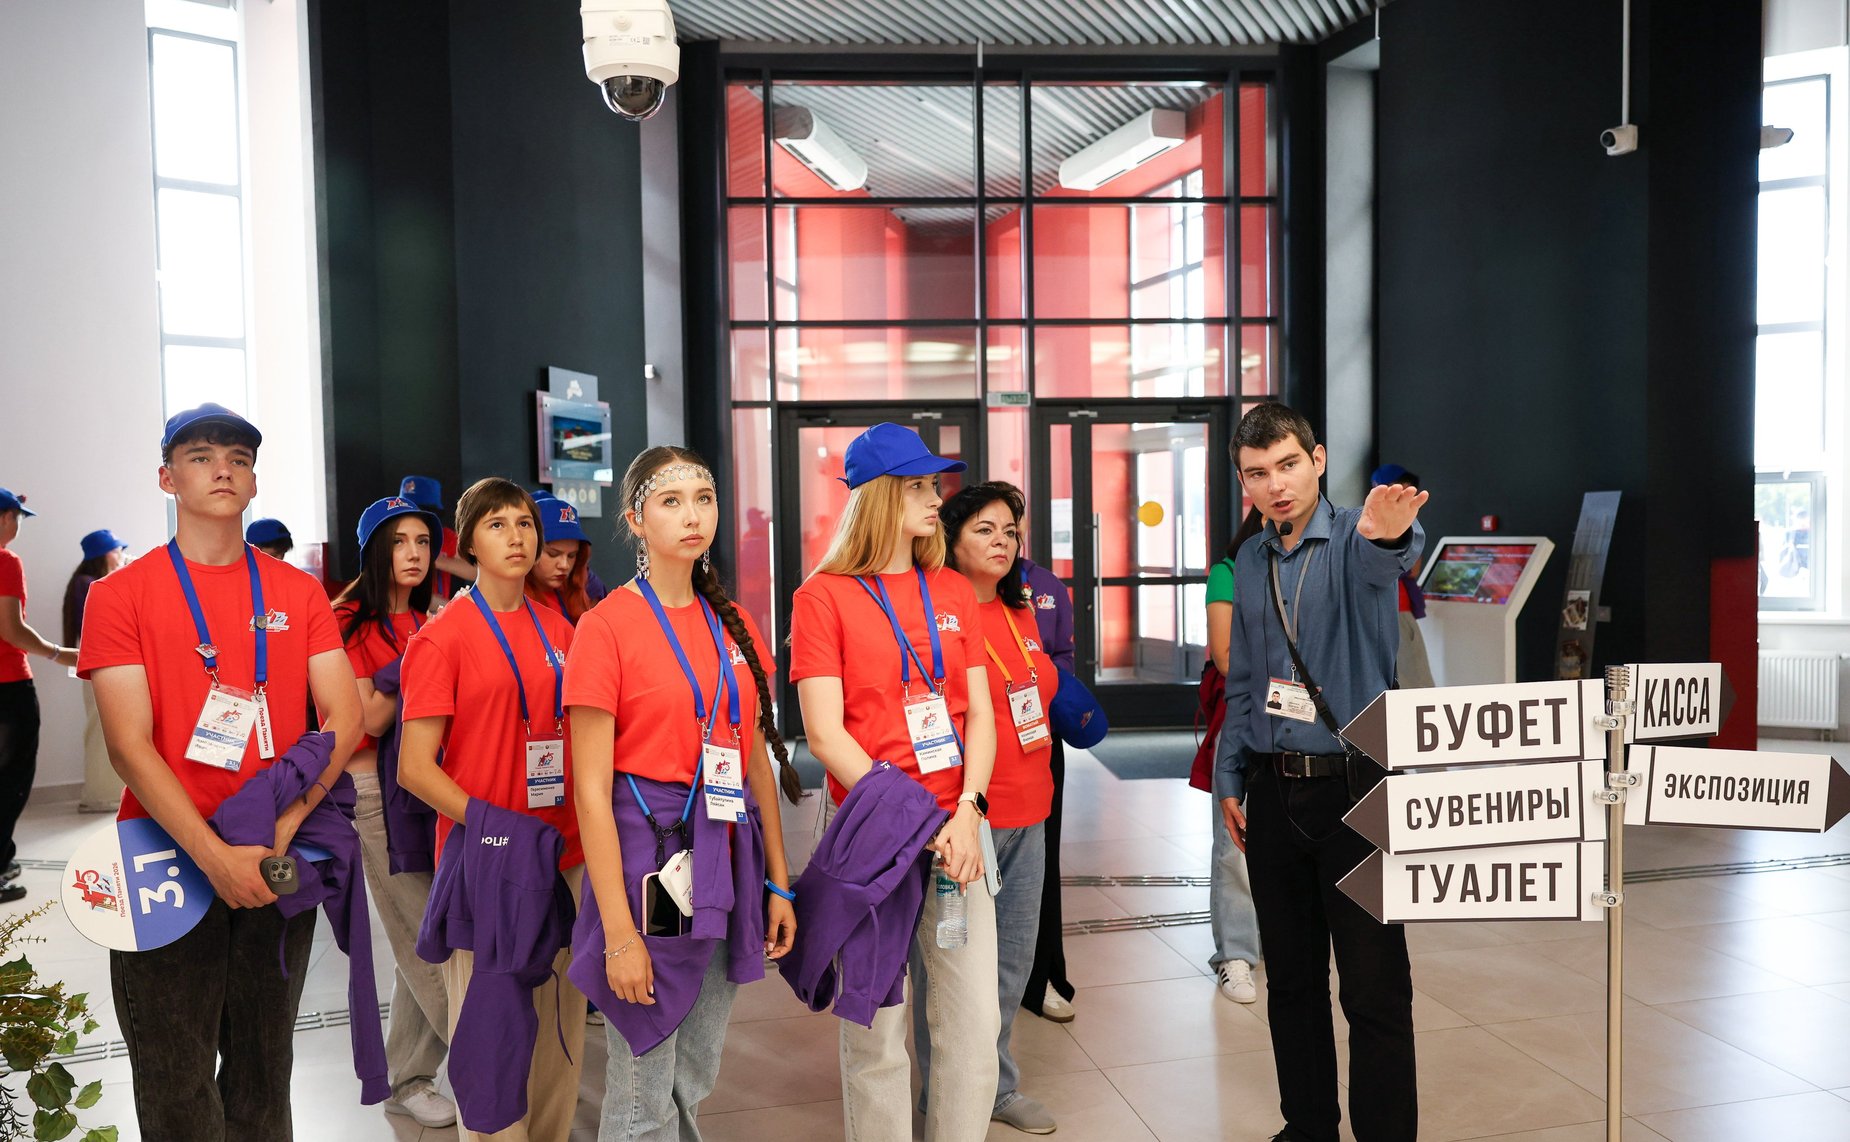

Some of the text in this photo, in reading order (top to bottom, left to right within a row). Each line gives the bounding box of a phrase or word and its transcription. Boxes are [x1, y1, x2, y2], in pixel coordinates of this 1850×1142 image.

[1643, 676, 1710, 728] КАССА
[1415, 697, 1568, 753] БУФЕТ
[1406, 787, 1570, 831] СУВЕНИРЫ
[1664, 773, 1810, 806] ЭКСПОЗИЦИЯ
[115, 876, 123, 899] Памяти
[133, 849, 185, 915] 3.1
[1405, 862, 1563, 904] ТУАЛЕТ
